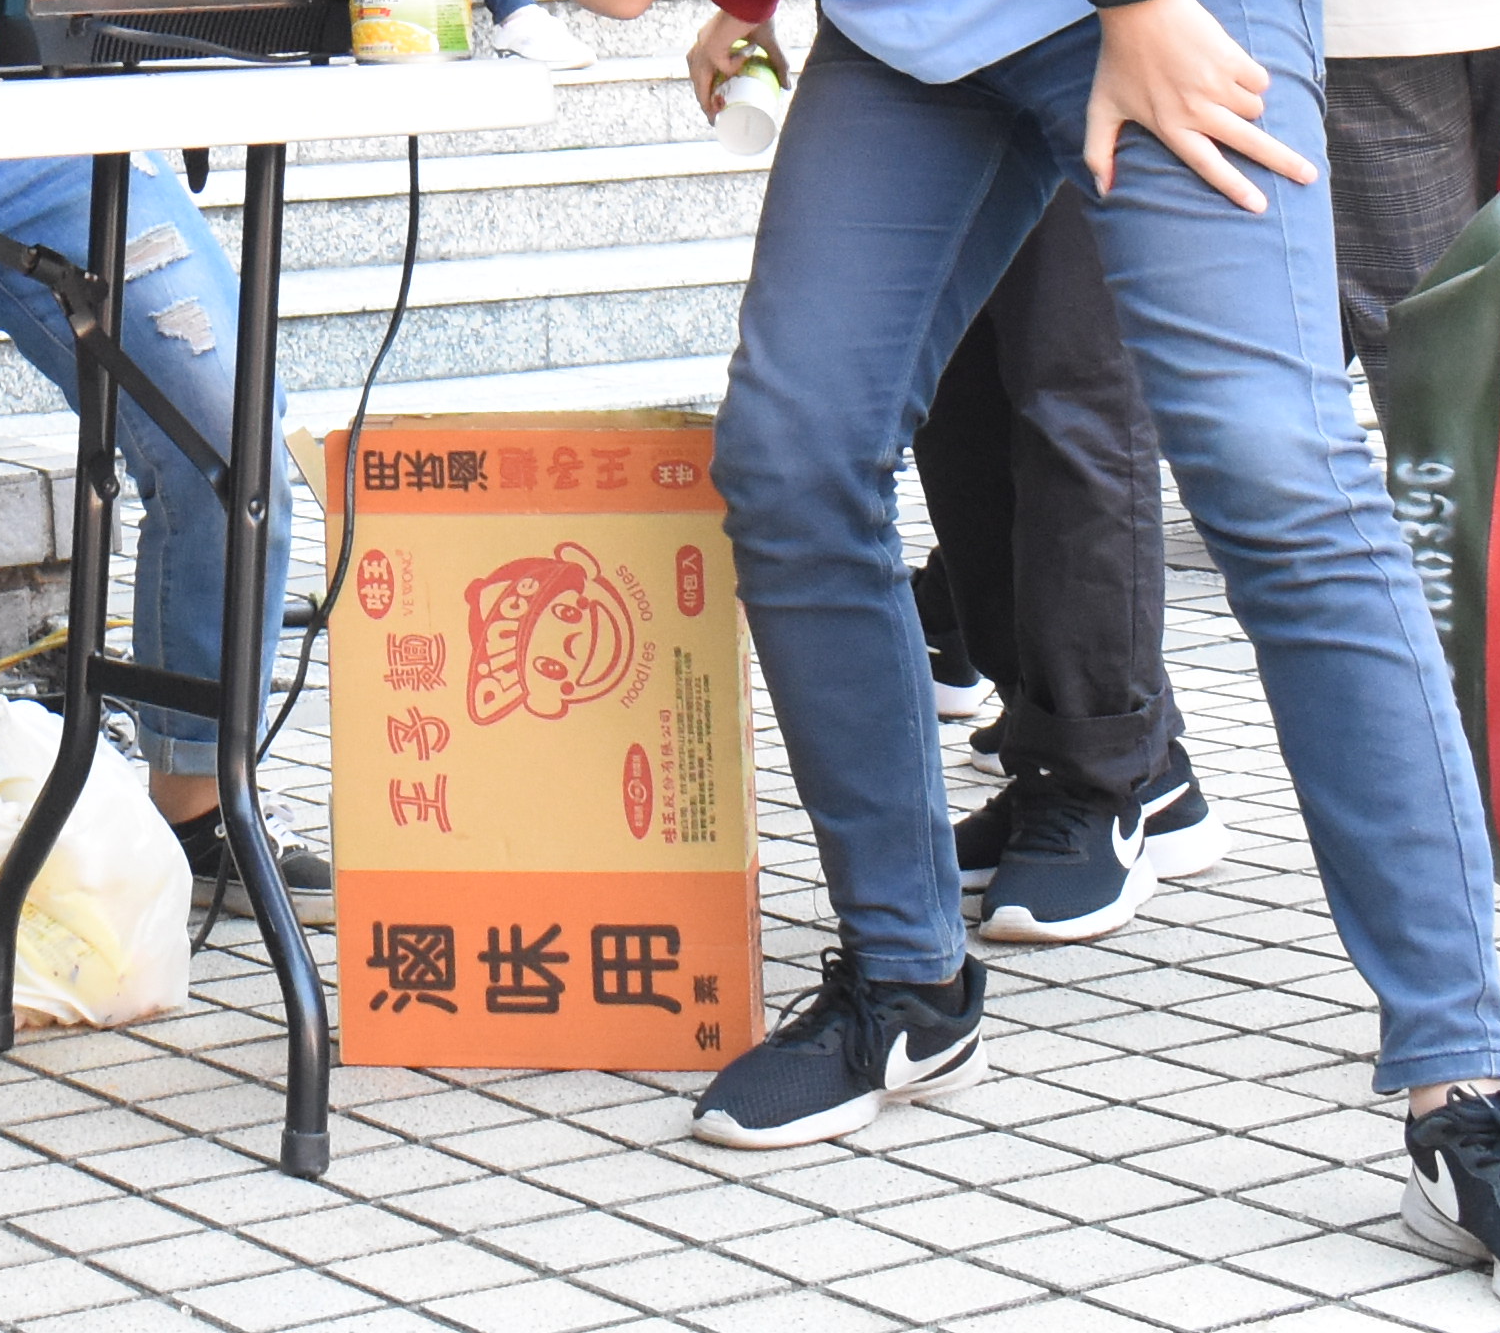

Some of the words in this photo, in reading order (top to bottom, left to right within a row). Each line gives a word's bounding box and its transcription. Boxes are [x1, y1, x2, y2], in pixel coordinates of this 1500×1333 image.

[363, 449, 489, 492] 滷味用
[359, 556, 391, 612] 味王
[682, 554, 701, 609] 40包入
[472, 577, 541, 717] Prince
[617, 641, 657, 709] noodles
[383, 632, 453, 833] 王子麵
[365, 920, 682, 1015] 滷味用
[693, 973, 721, 1051] 全素
